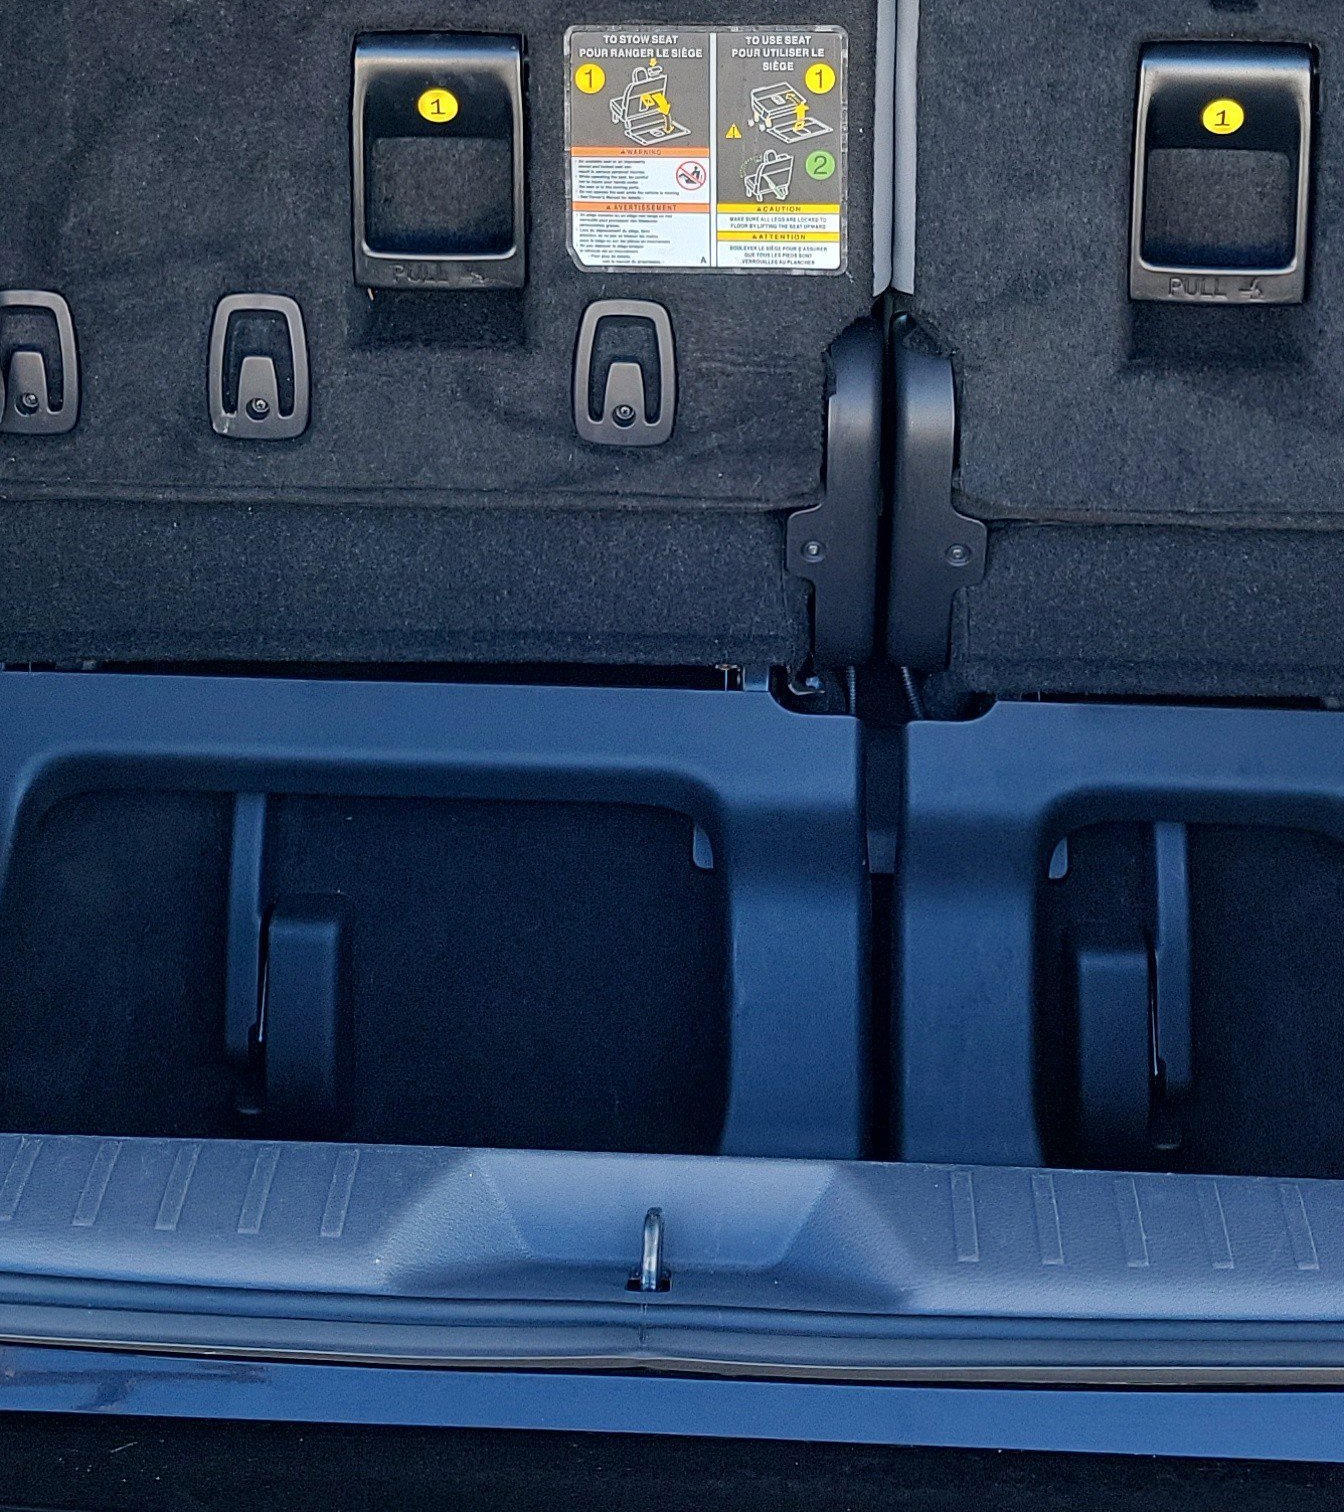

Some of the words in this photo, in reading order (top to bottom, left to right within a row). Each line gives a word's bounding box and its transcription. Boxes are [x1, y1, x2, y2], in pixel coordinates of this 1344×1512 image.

[603, 35, 618, 44] TO
[619, 35, 651, 44] STOW
[652, 35, 678, 44] SEAT
[745, 36, 760, 45] TO
[762, 36, 783, 45] USE
[784, 36, 812, 45] SEAT
[579, 48, 608, 58] POUR
[610, 48, 654, 58] RANGER
[656, 48, 670, 58] LE
[731, 48, 760, 58] POUR
[763, 48, 810, 58] UTILISER
[811, 48, 825, 58] LE
[813, 156, 828, 175] 2
[391, 264, 450, 284] PULL
[1168, 277, 1227, 297] PULL
